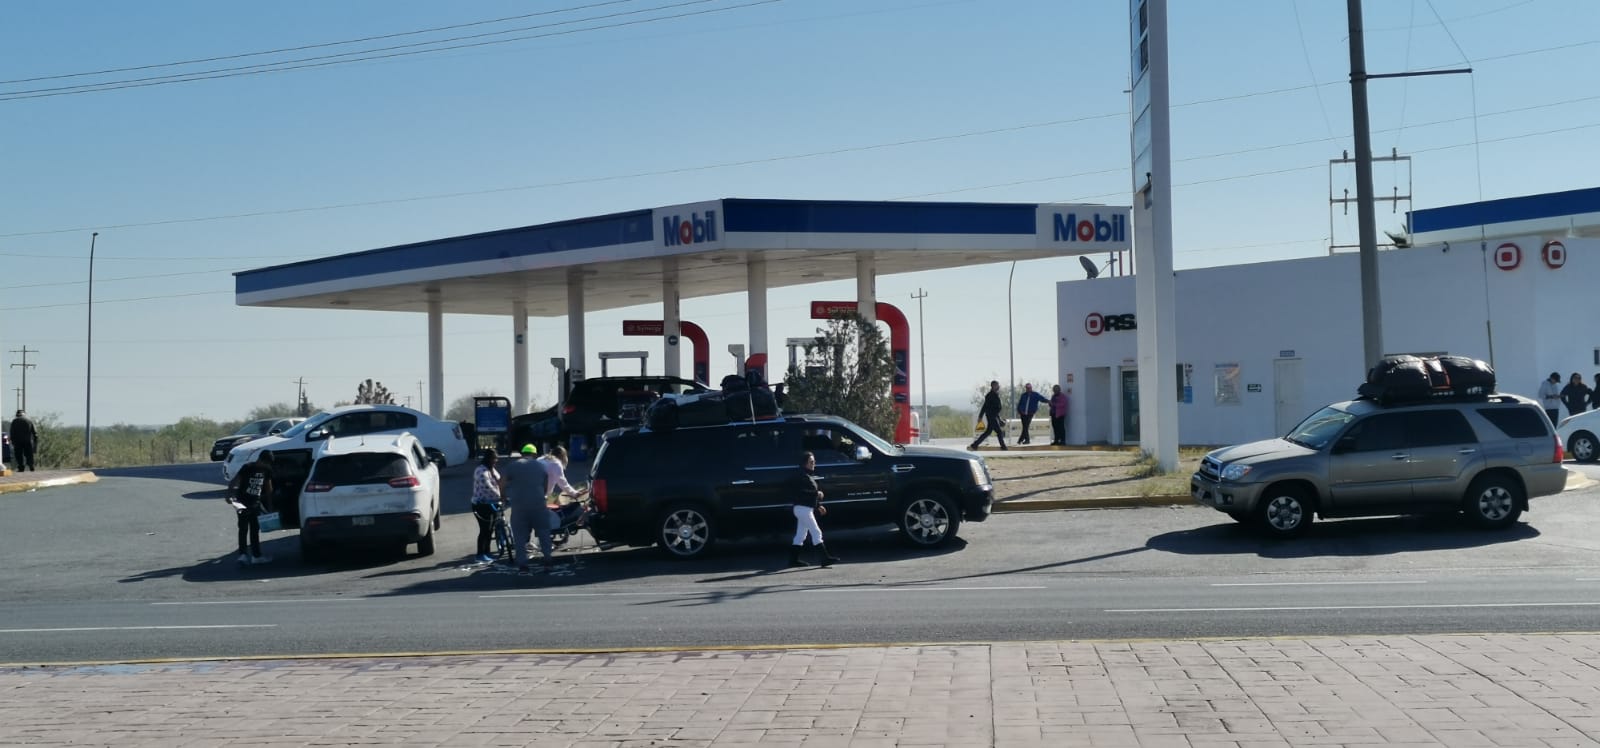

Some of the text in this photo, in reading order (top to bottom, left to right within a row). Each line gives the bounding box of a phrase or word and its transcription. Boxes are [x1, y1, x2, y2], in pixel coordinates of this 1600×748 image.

[663, 210, 717, 247] Mobil
[1053, 213, 1125, 242] Mobil
[1085, 312, 1137, 336] ORS
